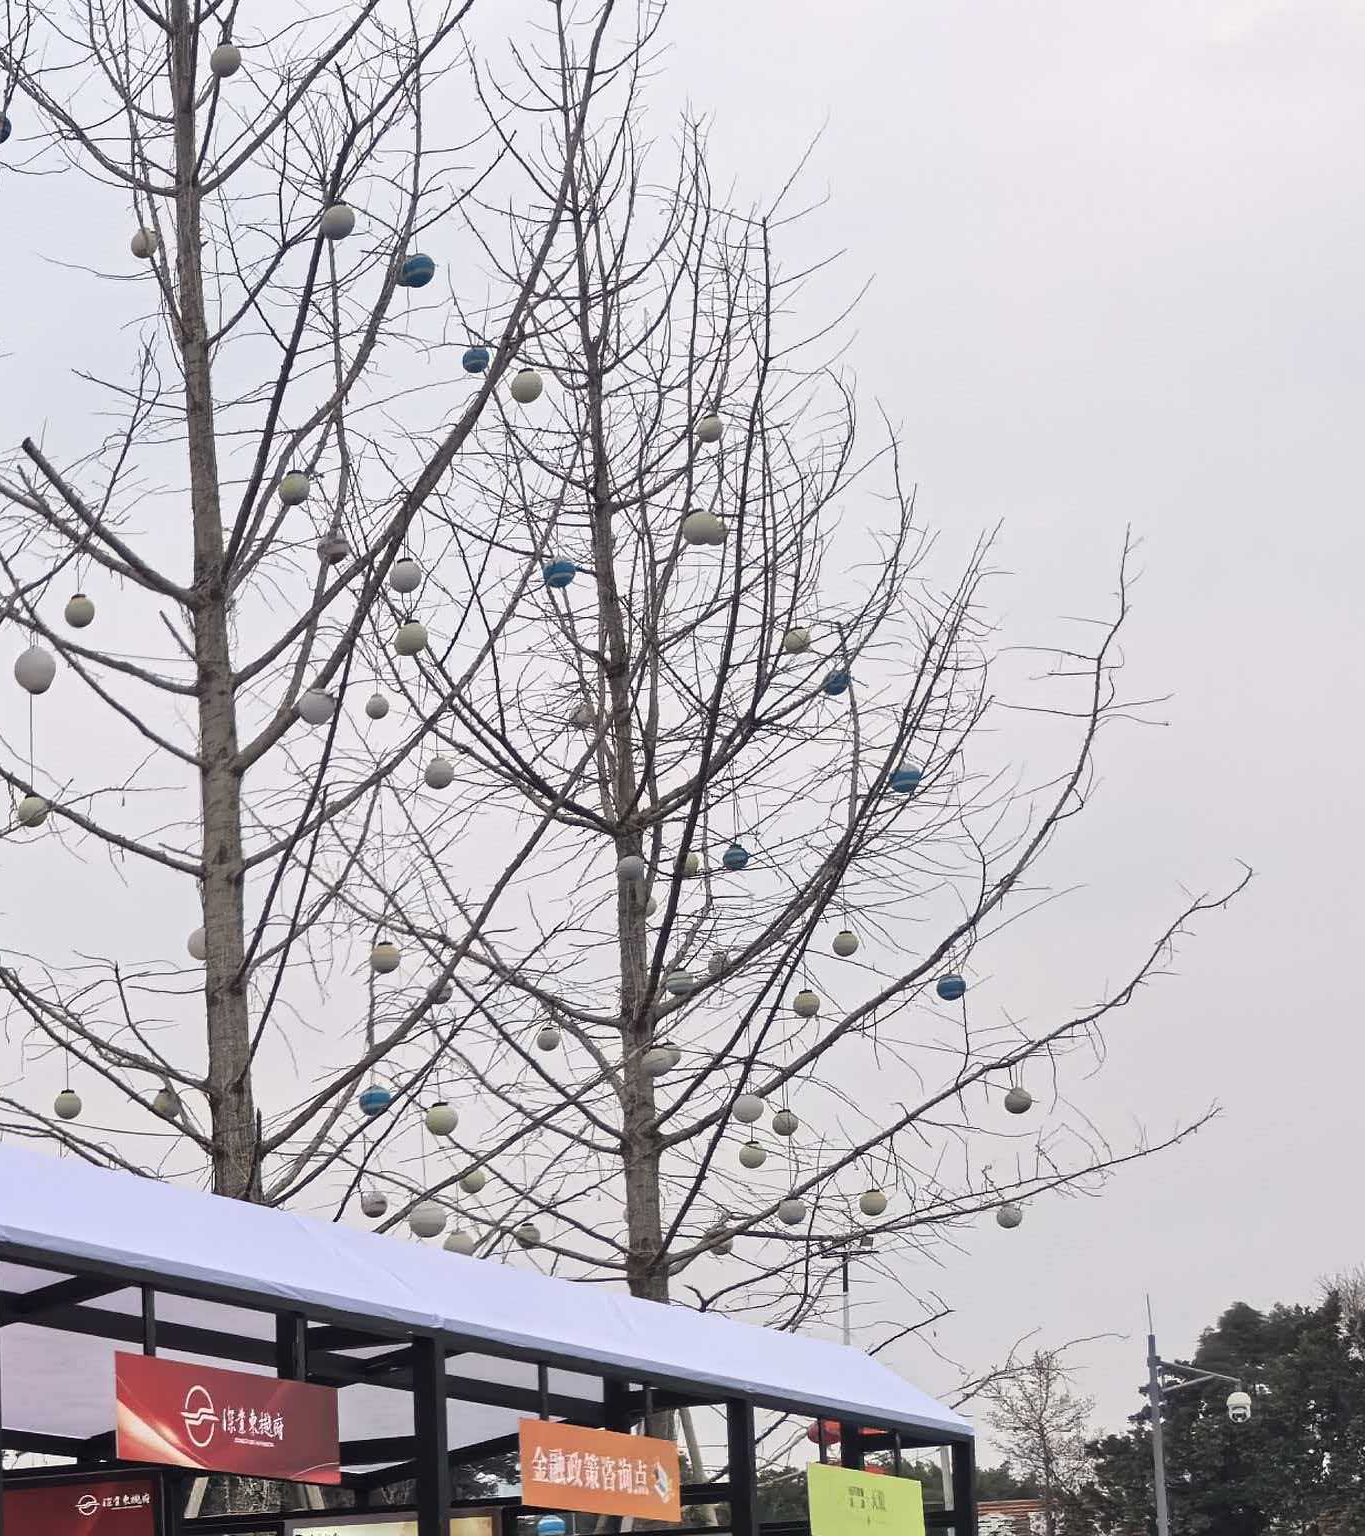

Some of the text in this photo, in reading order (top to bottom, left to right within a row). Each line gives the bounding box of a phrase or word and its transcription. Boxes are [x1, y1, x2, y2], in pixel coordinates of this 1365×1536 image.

[531, 1444, 649, 1497] 金融政策咨询点
